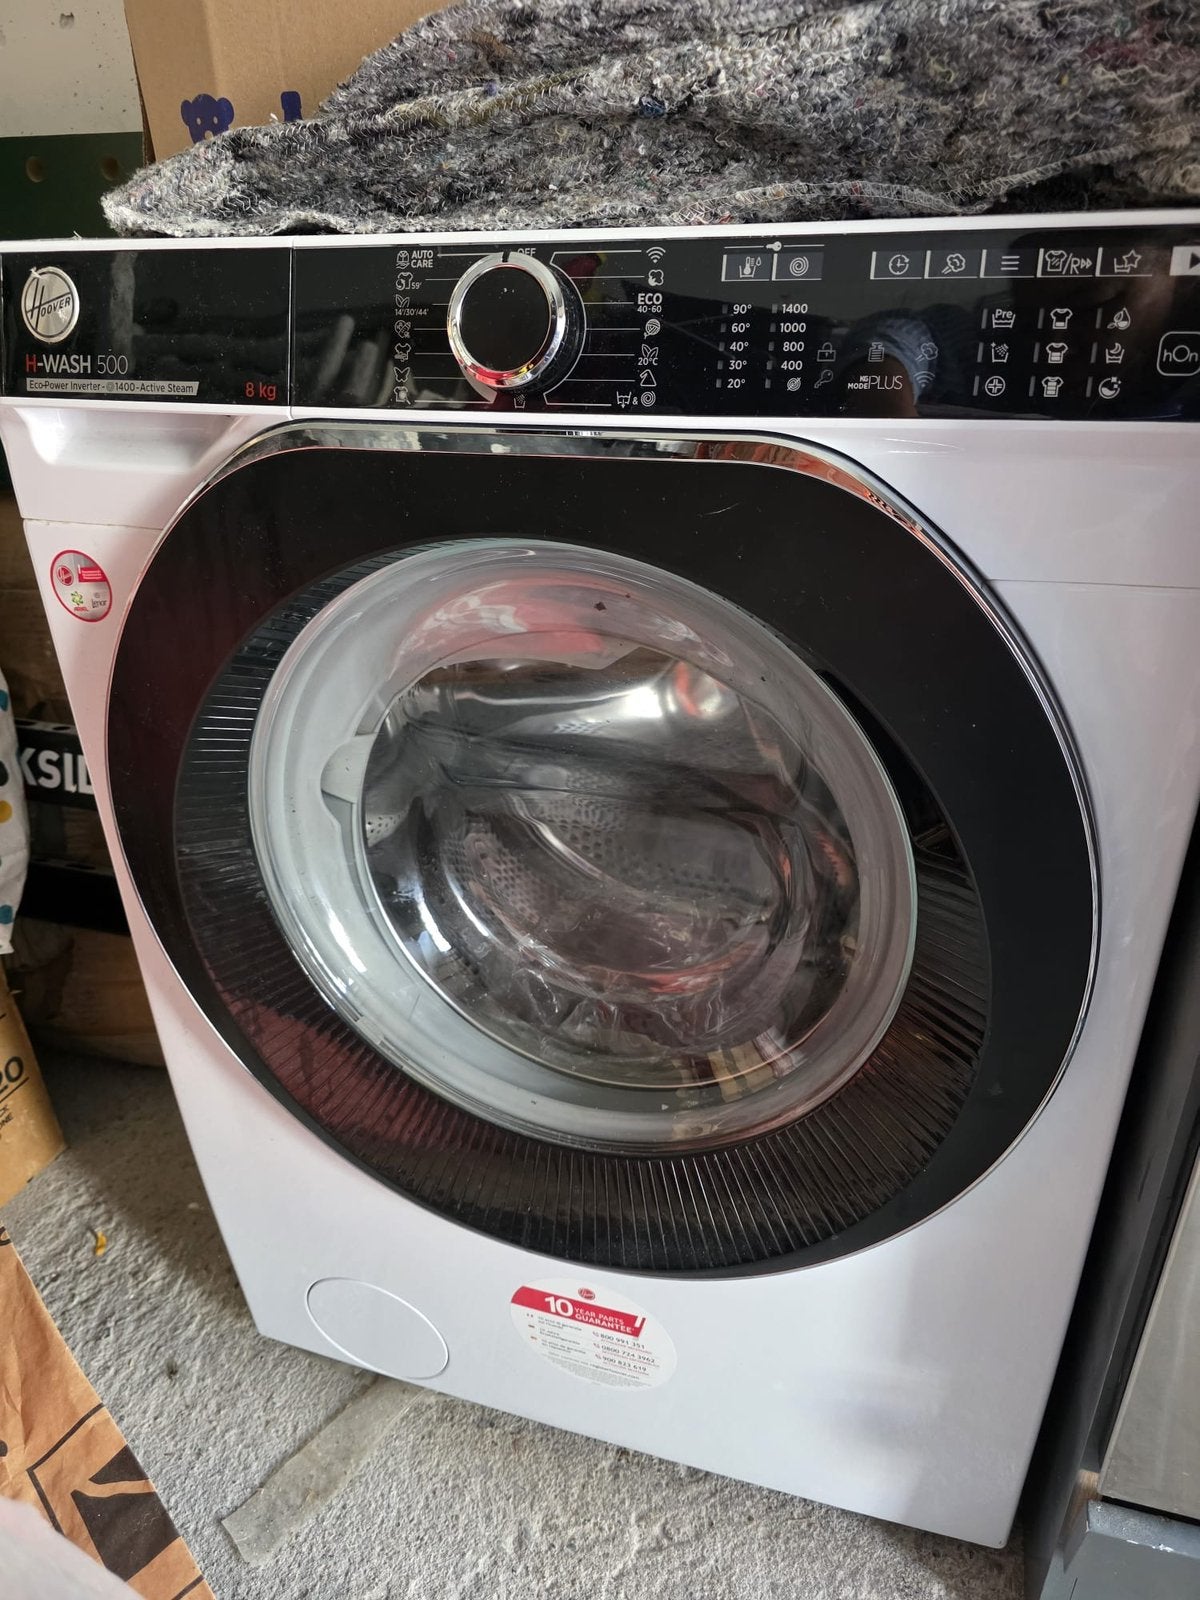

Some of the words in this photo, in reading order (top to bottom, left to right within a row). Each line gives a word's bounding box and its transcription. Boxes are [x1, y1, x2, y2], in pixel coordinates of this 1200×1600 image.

[411, 250, 434, 259] AUTO
[411, 259, 434, 268] CARE
[27, 278, 72, 330] HOOVER
[637, 293, 663, 305] ECO
[733, 304, 752, 314] 90°
[782, 303, 808, 314] 1400
[995, 308, 1013, 319] Pre
[731, 323, 750, 333] 60°
[780, 322, 807, 333] 1000
[729, 341, 749, 352] 40°
[783, 341, 805, 352] 800
[1162, 344, 1199, 363] hOn
[25, 354, 91, 374] H-WASH
[97, 354, 128, 375] 500
[638, 357, 659, 366] 20°C
[728, 360, 747, 370] 30°
[780, 360, 803, 370] 400
[167, 383, 194, 393] Steam
[727, 378, 746, 389] 20°
[868, 375, 904, 390] PLUS
[245, 382, 254, 398] 8
[259, 382, 276, 400] kg
[632, 396, 639, 405] &
[545, 1296, 574, 1317] 10
[574, 1307, 596, 1318] YEAR
[599, 1313, 625, 1325] PARTS
